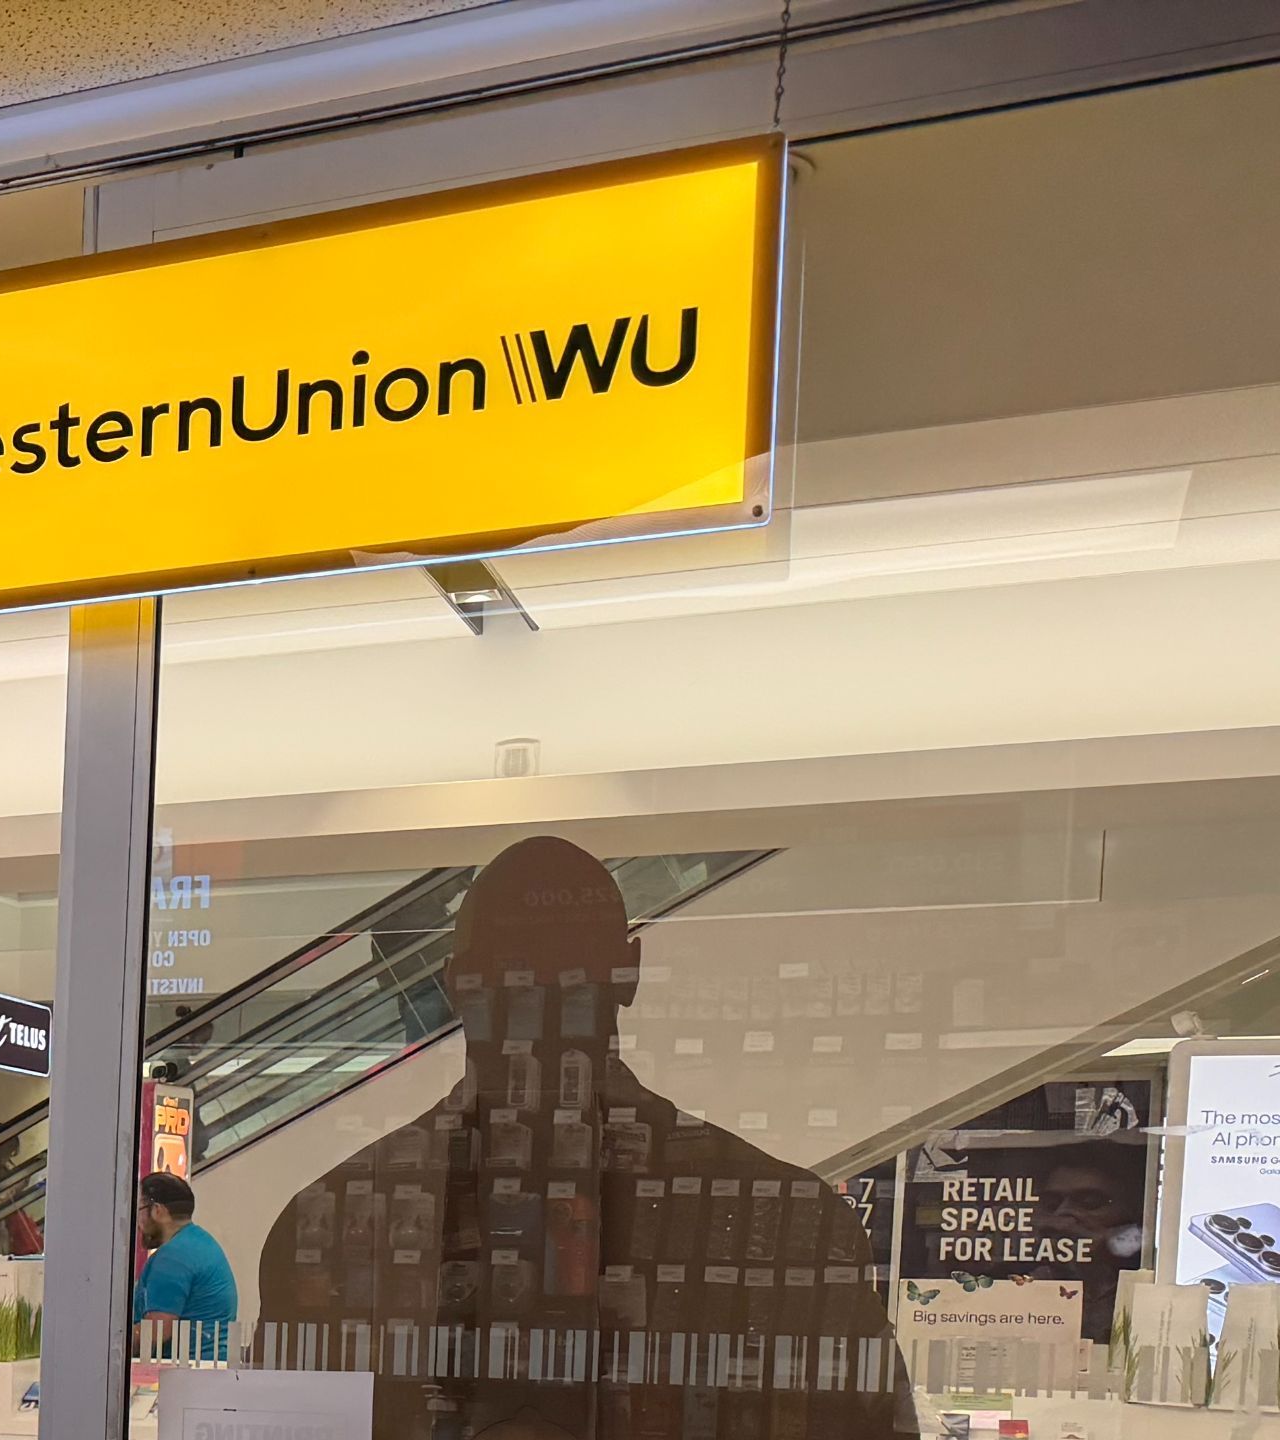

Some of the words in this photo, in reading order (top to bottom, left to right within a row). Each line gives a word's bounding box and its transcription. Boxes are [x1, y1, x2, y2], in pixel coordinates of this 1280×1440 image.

[9, 1021, 46, 1051] TELUS
[1201, 1110, 1236, 1125] The
[1212, 1131, 1231, 1146] AI
[1210, 1155, 1268, 1165] SAMSUNG
[941, 1177, 1040, 1203] RETAIL
[940, 1207, 1033, 1232] SPACE
[939, 1237, 992, 1262] FOR
[1002, 1238, 1093, 1263] LEASE
[912, 1309, 937, 1326] Big
[940, 1310, 996, 1326] savings
[998, 1313, 1023, 1325] are
[1027, 1310, 1065, 1325] here.
